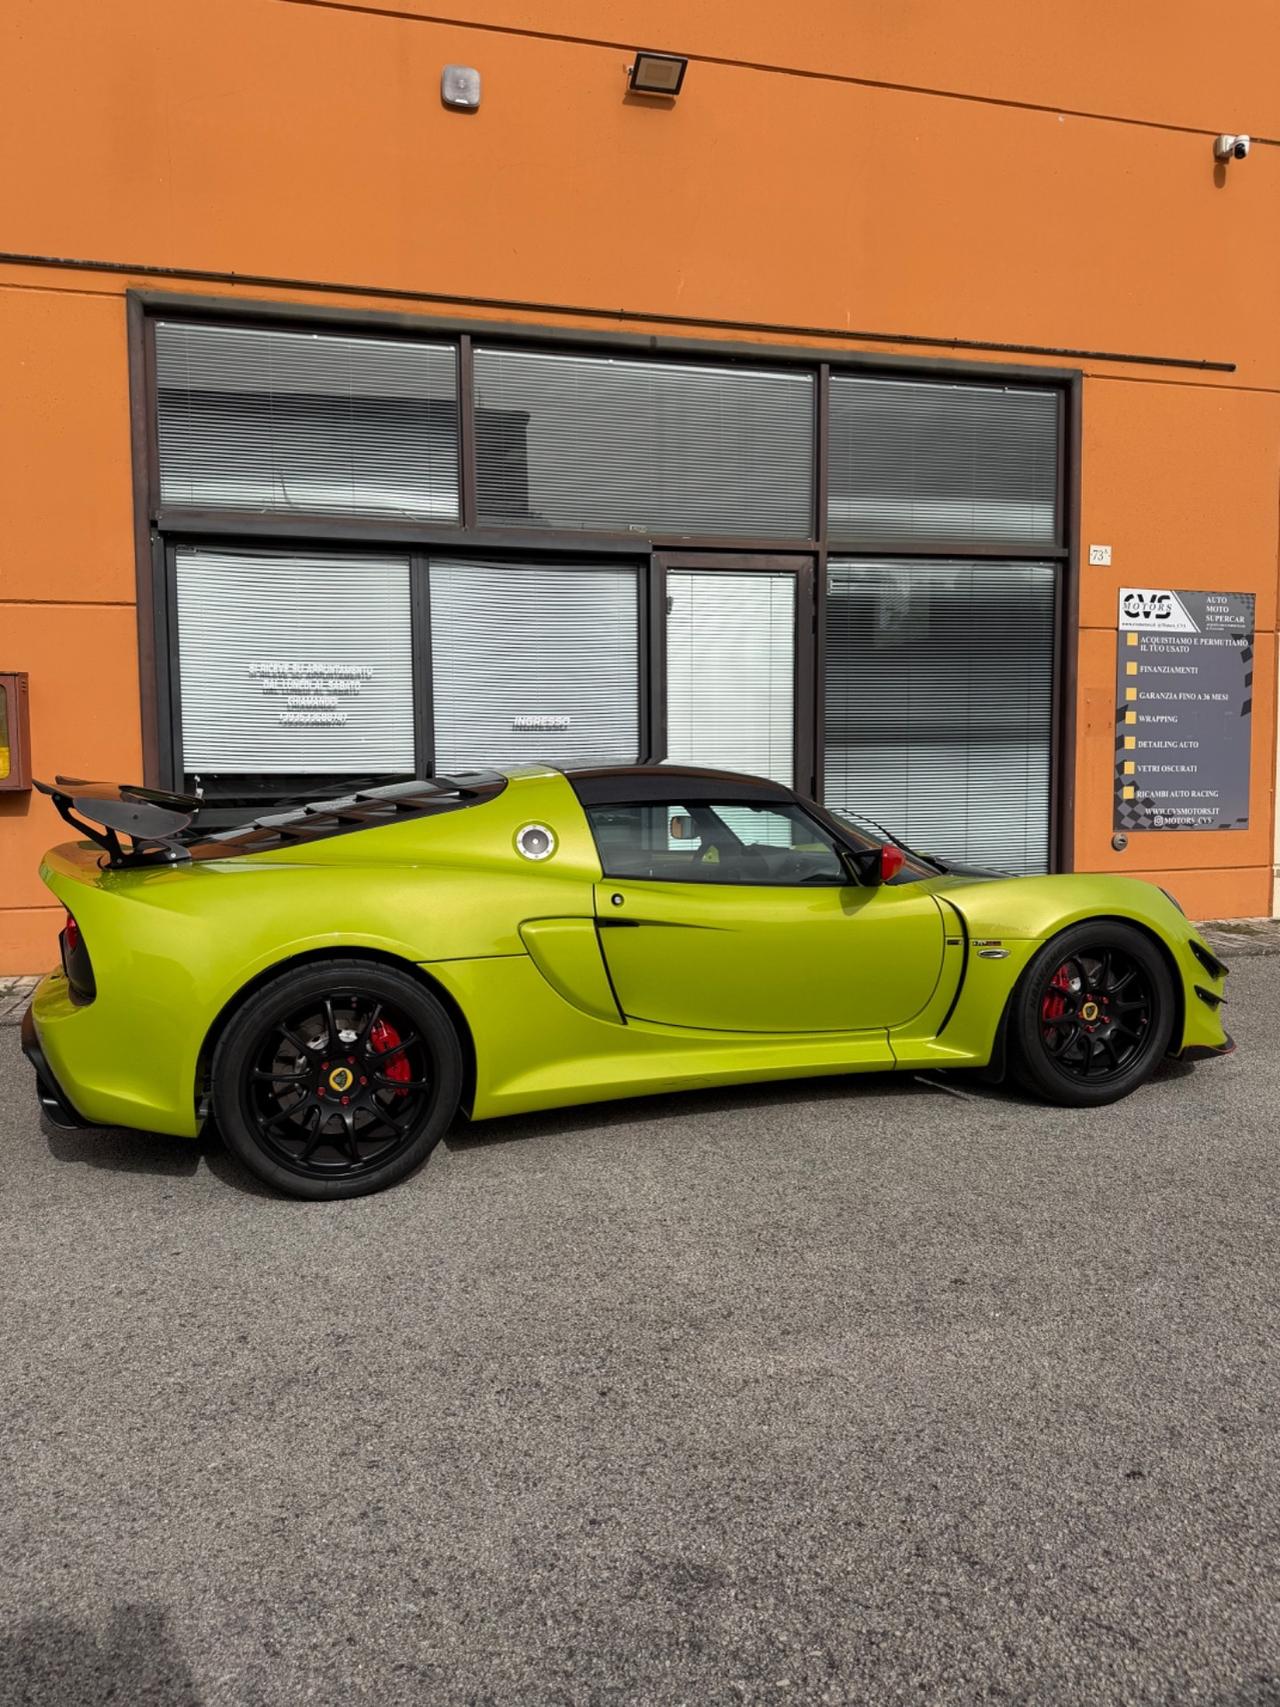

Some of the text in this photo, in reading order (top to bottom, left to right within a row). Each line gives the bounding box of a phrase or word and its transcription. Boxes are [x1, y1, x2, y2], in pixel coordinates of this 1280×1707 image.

[1206, 596, 1228, 604] AUTO
[1122, 602, 1173, 612] MOTORS
[1124, 594, 1171, 619] CVS
[1206, 605, 1230, 613] MOTO
[1205, 615, 1246, 623] SUPERCAR
[1140, 635, 1193, 646] ACQUISTIAMO
[1200, 638, 1249, 647] PERMUTIAMO
[1140, 644, 1190, 653] IL TUO USATO
[1139, 665, 1198, 674] FINANZIAMENTI
[1139, 691, 1177, 700] GARANZIA
[1178, 692, 1196, 700] FINO
[1197, 692, 1202, 700] A
[1211, 692, 1229, 701] MESI
[514, 715, 571, 726] INGRESSO
[1138, 715, 1178, 723] WRAPPING
[1161, 765, 1198, 773] OSCURATI
[1170, 790, 1190, 798] AUTO
[1191, 790, 1219, 798] RACING
